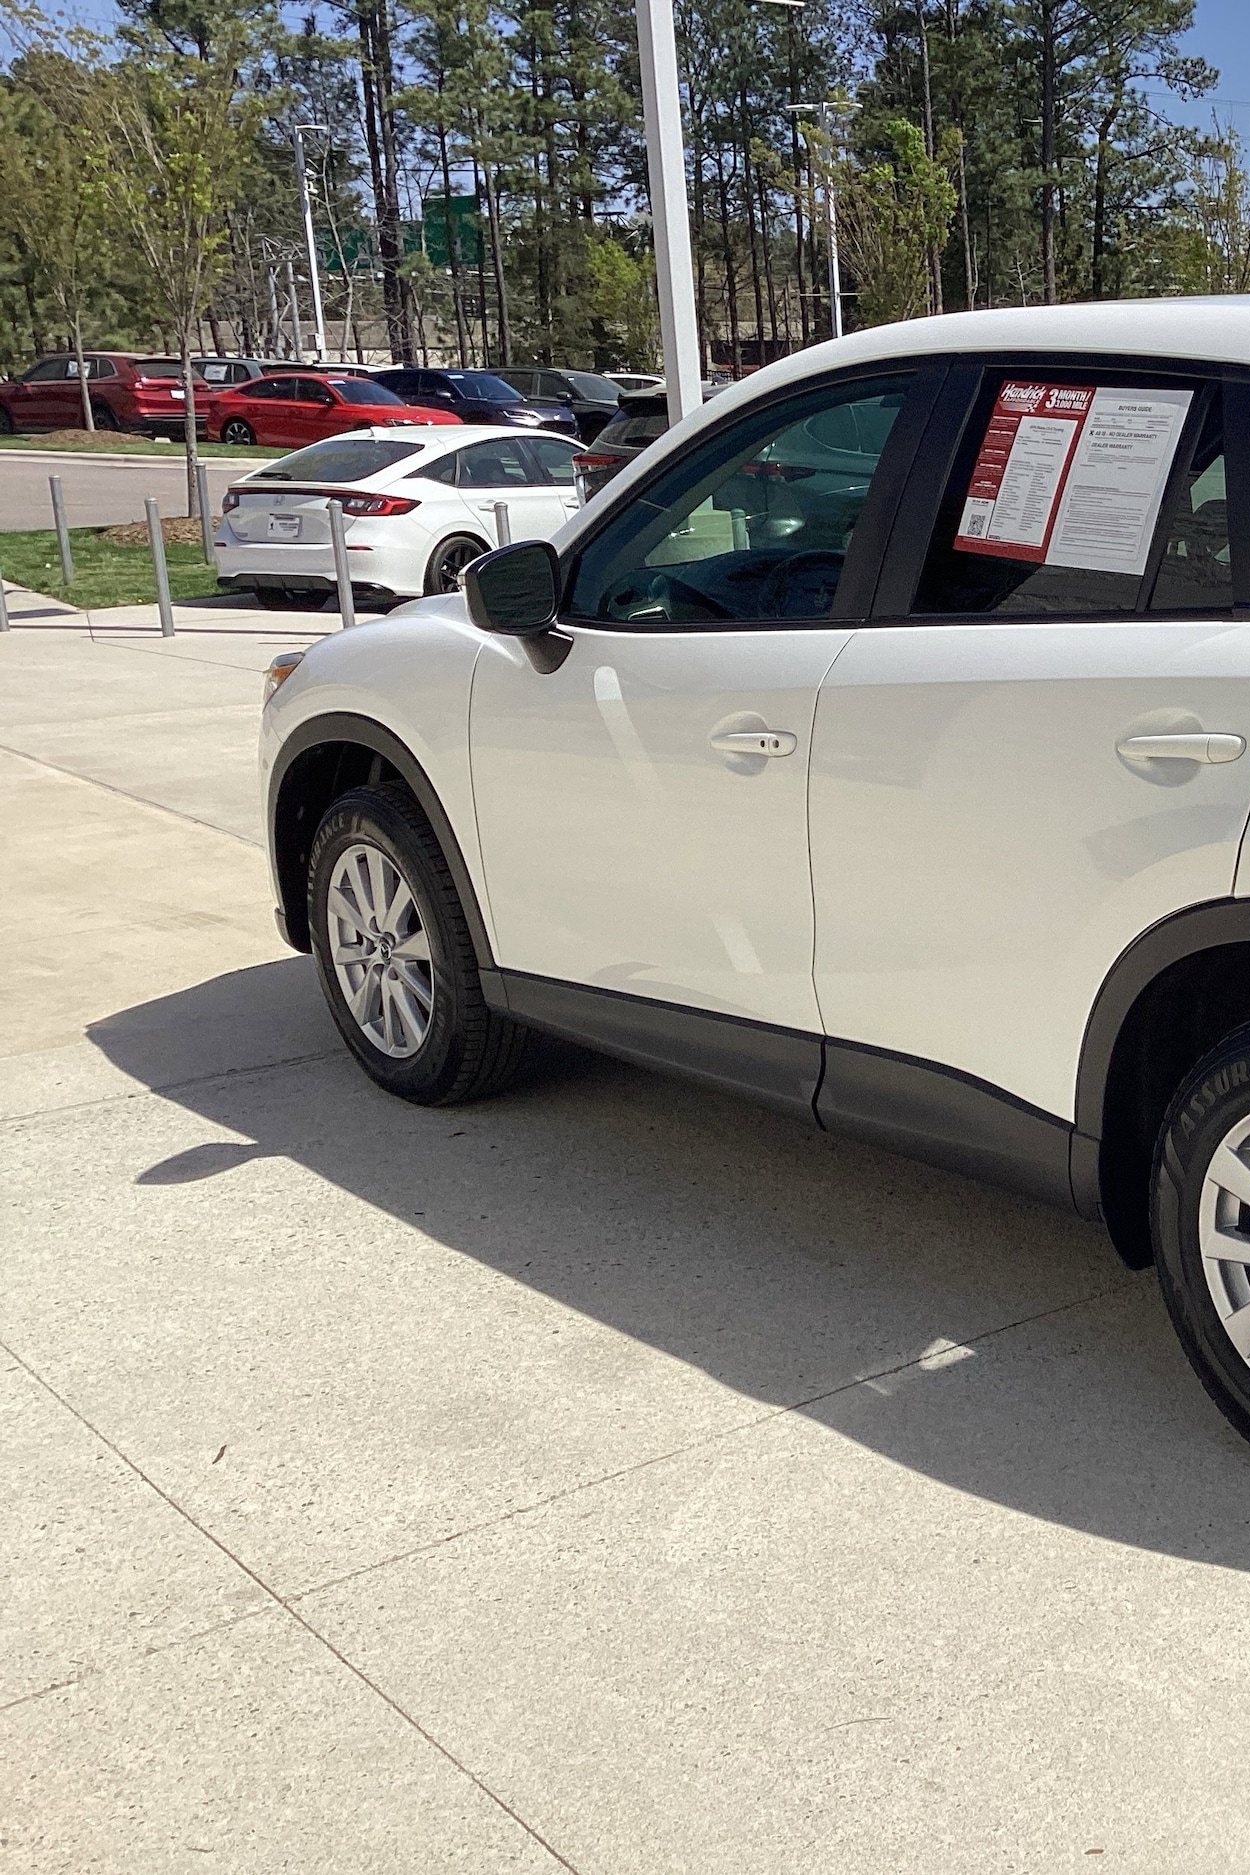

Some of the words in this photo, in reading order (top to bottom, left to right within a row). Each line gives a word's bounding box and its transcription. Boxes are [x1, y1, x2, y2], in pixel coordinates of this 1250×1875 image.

[1001, 383, 1047, 402] Hendrick
[1045, 388, 1059, 409] 3
[1071, 401, 1089, 410] MILE
